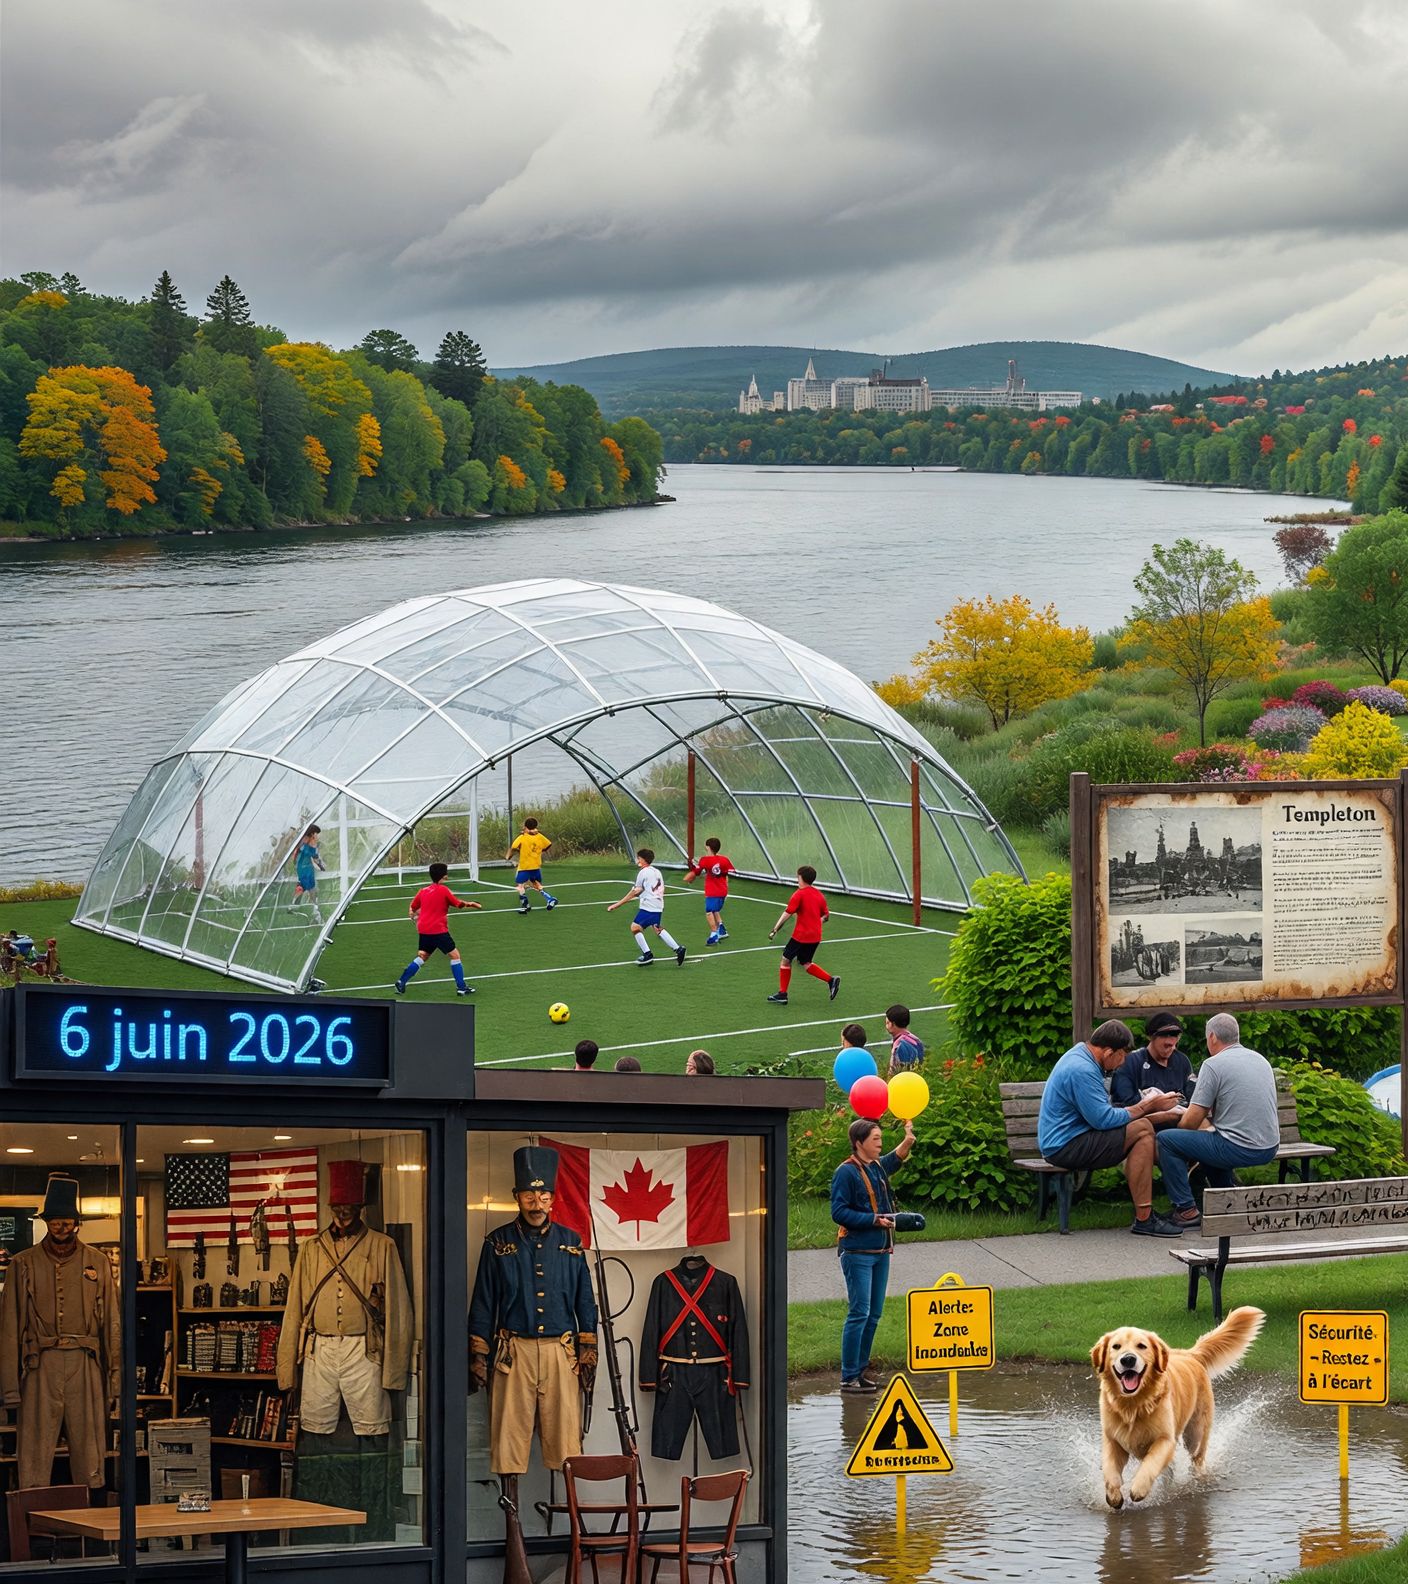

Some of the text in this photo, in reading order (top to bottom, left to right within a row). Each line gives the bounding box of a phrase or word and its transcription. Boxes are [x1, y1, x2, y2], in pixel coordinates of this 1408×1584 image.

[1281, 803, 1376, 827] Templeton
[60, 1005, 354, 1072] 6 juin 2026
[933, 1322, 969, 1338] Zone
[1308, 1372, 1373, 1390] à l'écart
